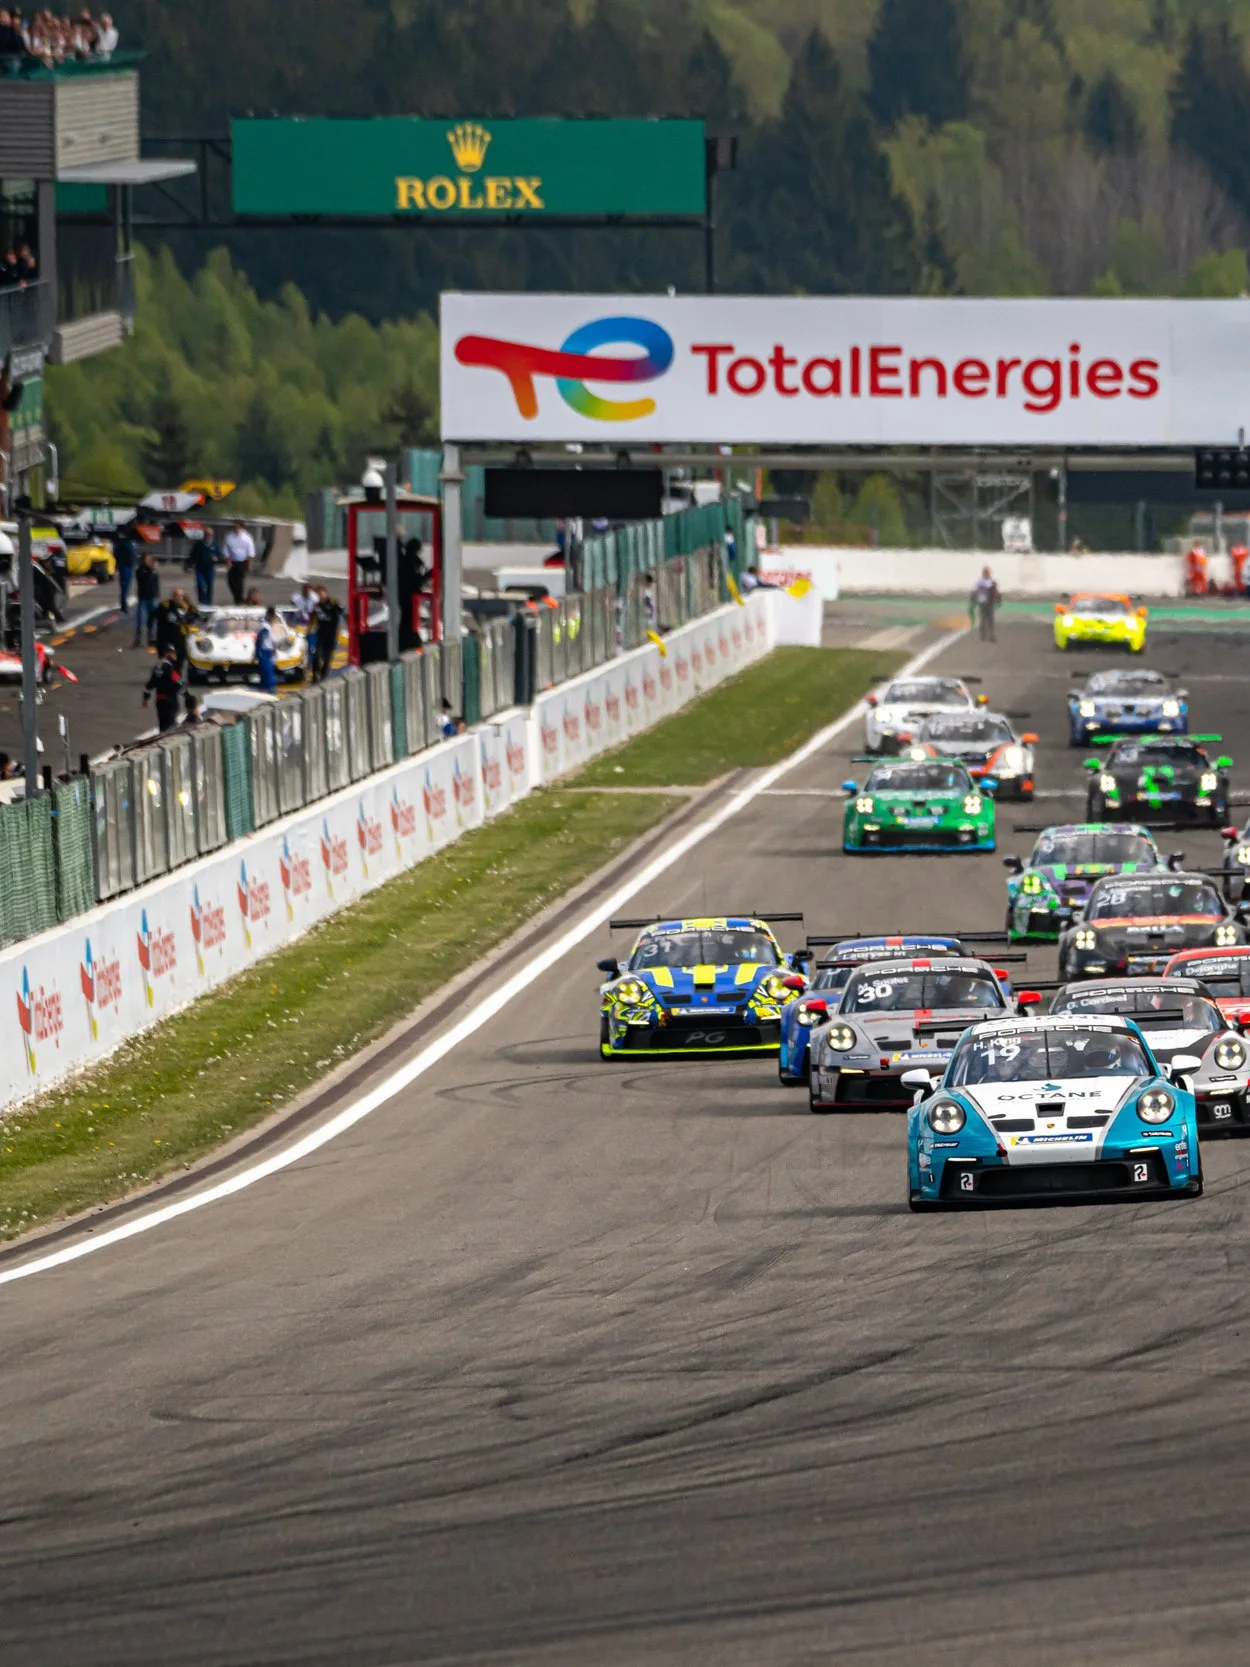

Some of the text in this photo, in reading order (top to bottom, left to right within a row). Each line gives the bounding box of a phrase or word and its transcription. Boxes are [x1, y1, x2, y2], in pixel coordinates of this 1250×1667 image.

[394, 175, 545, 210] ROLEX
[691, 342, 1160, 414] TotalEnergies
[1097, 889, 1128, 907] 28
[643, 939, 672, 958] 31
[839, 944, 947, 955] PORSCHE
[865, 966, 978, 977] PORSCHE
[857, 984, 893, 1004] 30
[1072, 986, 1196, 999] PORSCHE
[979, 1025, 1112, 1040] PORSCHE
[973, 1041, 987, 1051] H.
[980, 1044, 1021, 1066] 19
[997, 1090, 1103, 1101] OCTANE
[1032, 1134, 1089, 1143] MICHELIN
